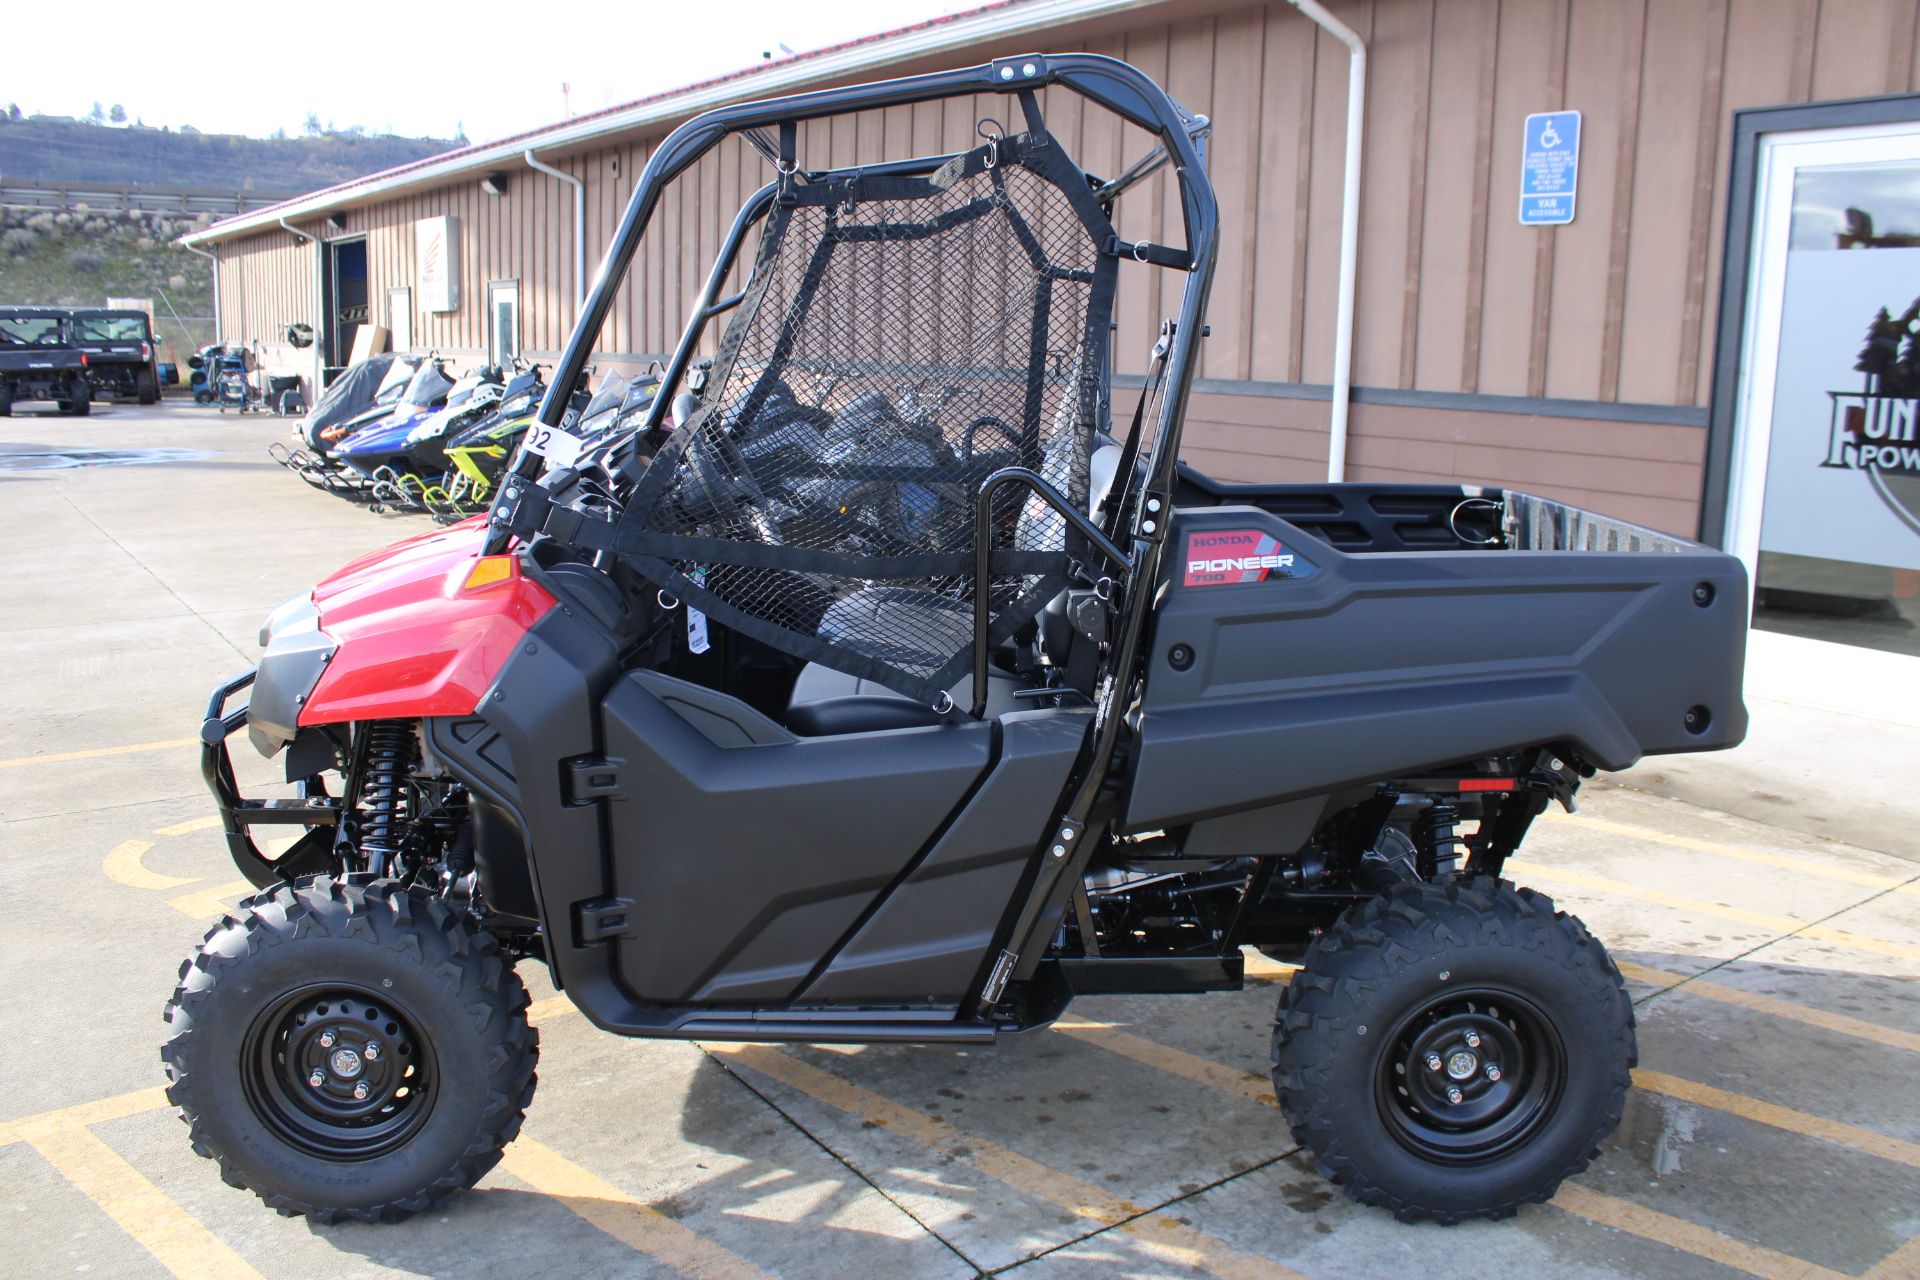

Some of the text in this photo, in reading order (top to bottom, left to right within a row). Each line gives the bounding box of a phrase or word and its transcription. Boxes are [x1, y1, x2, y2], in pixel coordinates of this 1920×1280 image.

[1538, 198, 1557, 208] VAN
[1528, 208, 1566, 217] ACCESSIBLE
[1820, 392, 1918, 468] FUN
[1193, 535, 1254, 547] HONDA
[1188, 554, 1294, 573] PIONEER
[1192, 573, 1225, 582] 700
